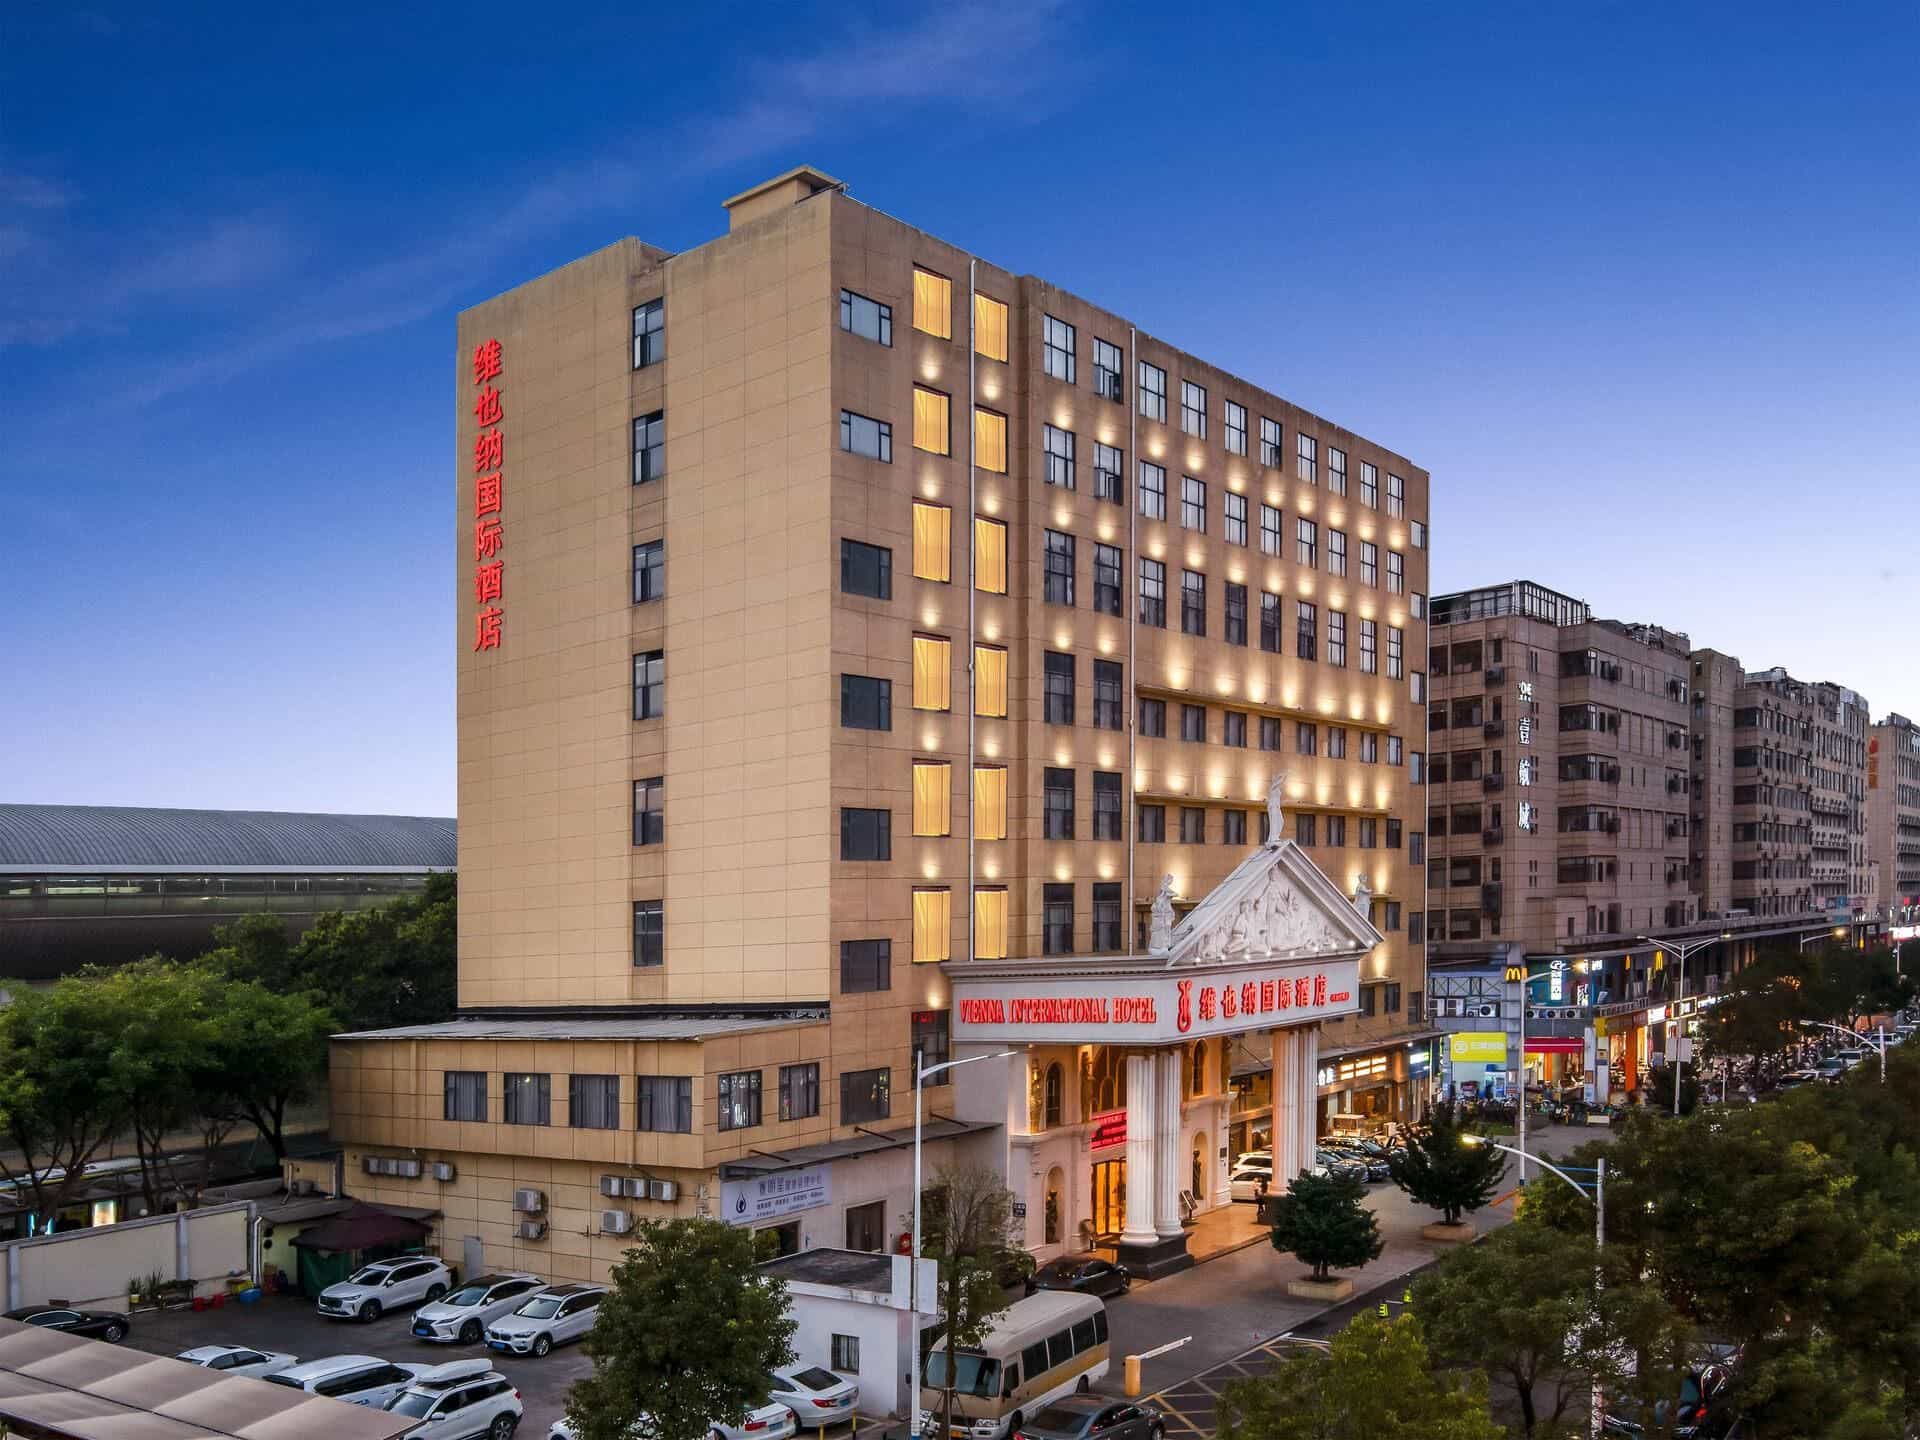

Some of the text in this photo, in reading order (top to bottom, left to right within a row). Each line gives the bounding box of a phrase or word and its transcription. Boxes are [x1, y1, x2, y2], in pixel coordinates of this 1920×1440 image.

[473, 337, 504, 652] 维也纳国际酒店
[960, 998, 1006, 1024] VIENNA
[1008, 997, 1109, 1024] INTERNATIONAL
[1112, 997, 1157, 1024] HOTEL
[1199, 974, 1328, 1023] 维也纳国际酒店
